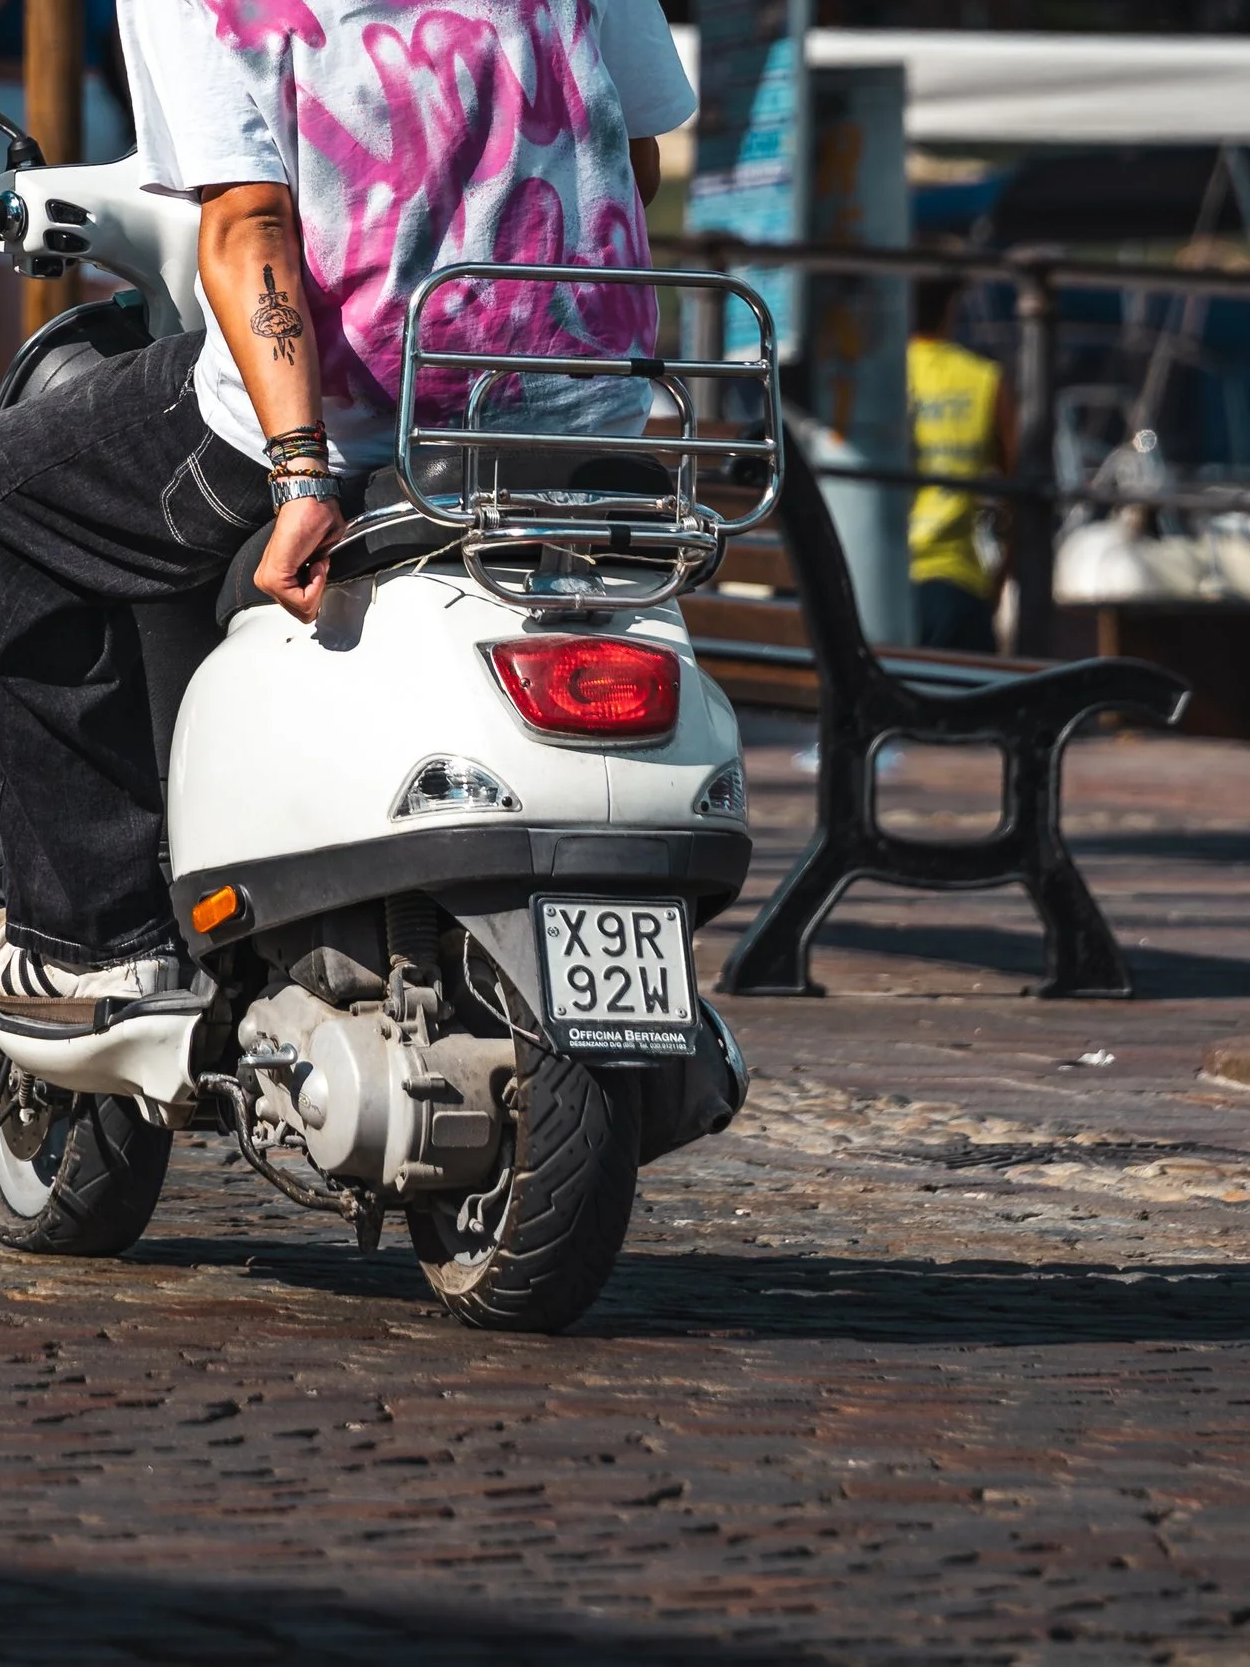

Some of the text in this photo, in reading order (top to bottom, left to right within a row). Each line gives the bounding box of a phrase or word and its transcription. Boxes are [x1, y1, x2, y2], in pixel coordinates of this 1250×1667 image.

[559, 909, 664, 959] X9R
[567, 964, 670, 1014] 92W
[569, 1028, 686, 1043] OFFICINA BERTAGNA
